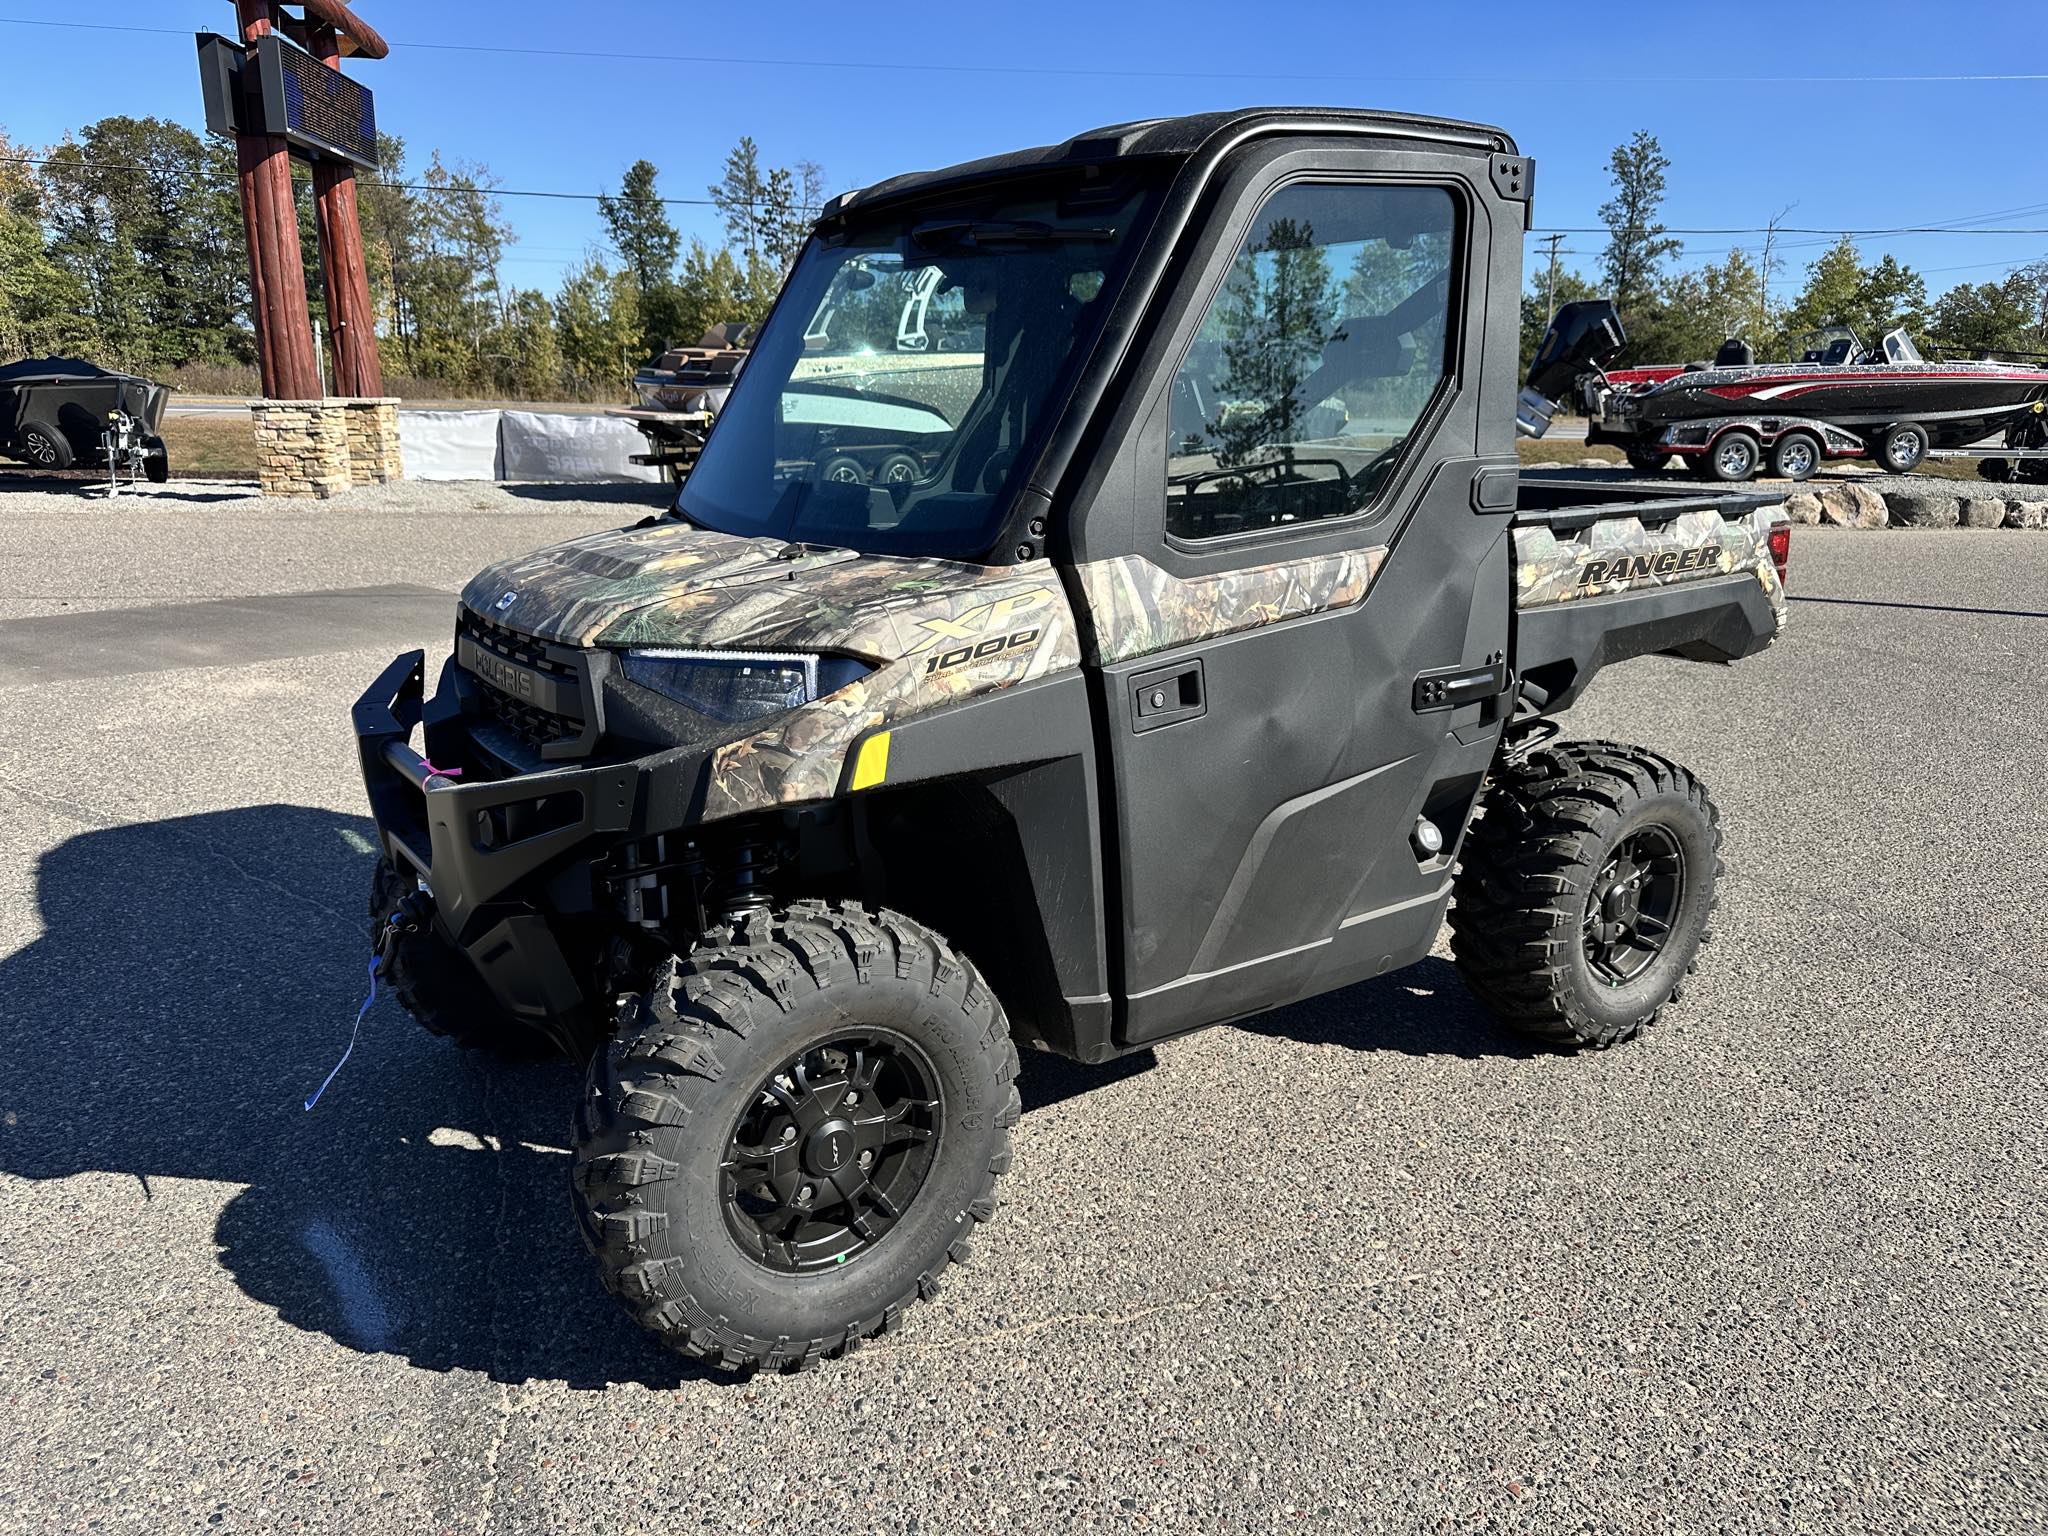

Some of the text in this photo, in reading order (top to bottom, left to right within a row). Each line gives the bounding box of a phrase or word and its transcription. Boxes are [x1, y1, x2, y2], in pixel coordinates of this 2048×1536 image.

[1577, 545, 1722, 588] RANGER
[895, 587, 1056, 660] XP
[475, 649, 531, 697] POLARIS
[926, 628, 1040, 675] 1000
